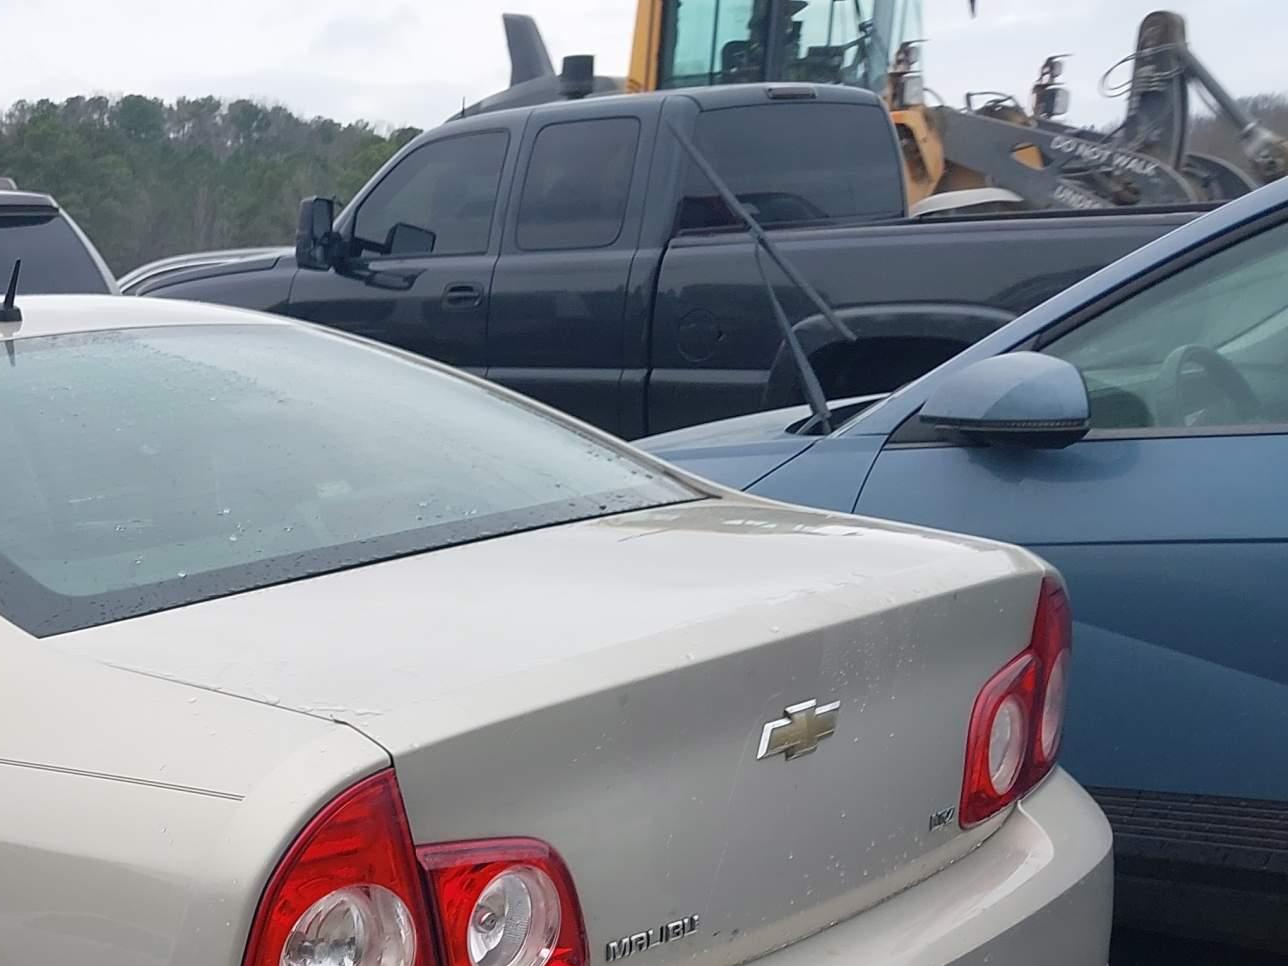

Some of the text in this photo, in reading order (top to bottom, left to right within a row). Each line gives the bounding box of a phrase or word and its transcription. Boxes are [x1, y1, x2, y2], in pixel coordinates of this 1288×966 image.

[1050, 135, 1161, 177] DO NOT WALK
[605, 914, 701, 962] MALIBU
